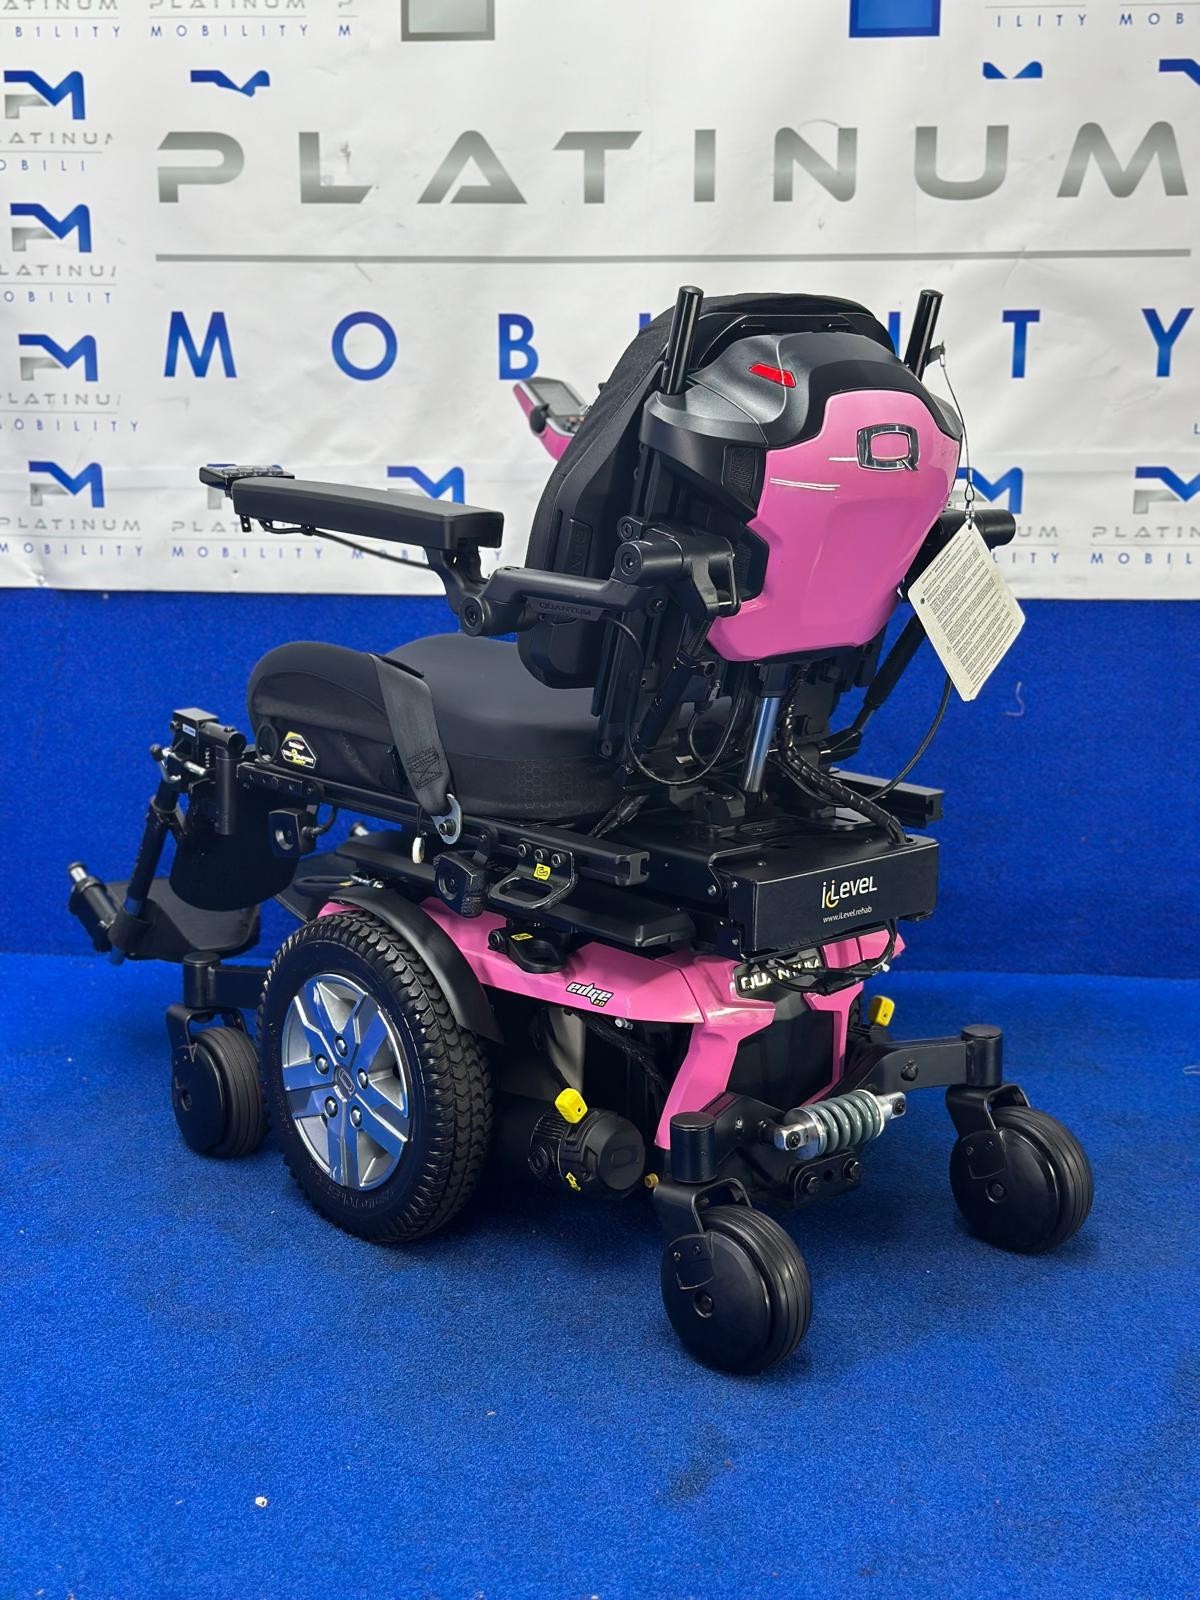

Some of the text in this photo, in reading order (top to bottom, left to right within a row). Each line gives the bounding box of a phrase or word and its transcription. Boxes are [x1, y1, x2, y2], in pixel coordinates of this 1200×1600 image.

[150, 25, 307, 37] MOBILITY
[157, 121, 1188, 204] PLATINUM
[164, 306, 1194, 381] MOBTY
[0, 418, 139, 432] OBILITY
[172, 546, 323, 559] MOBILITY
